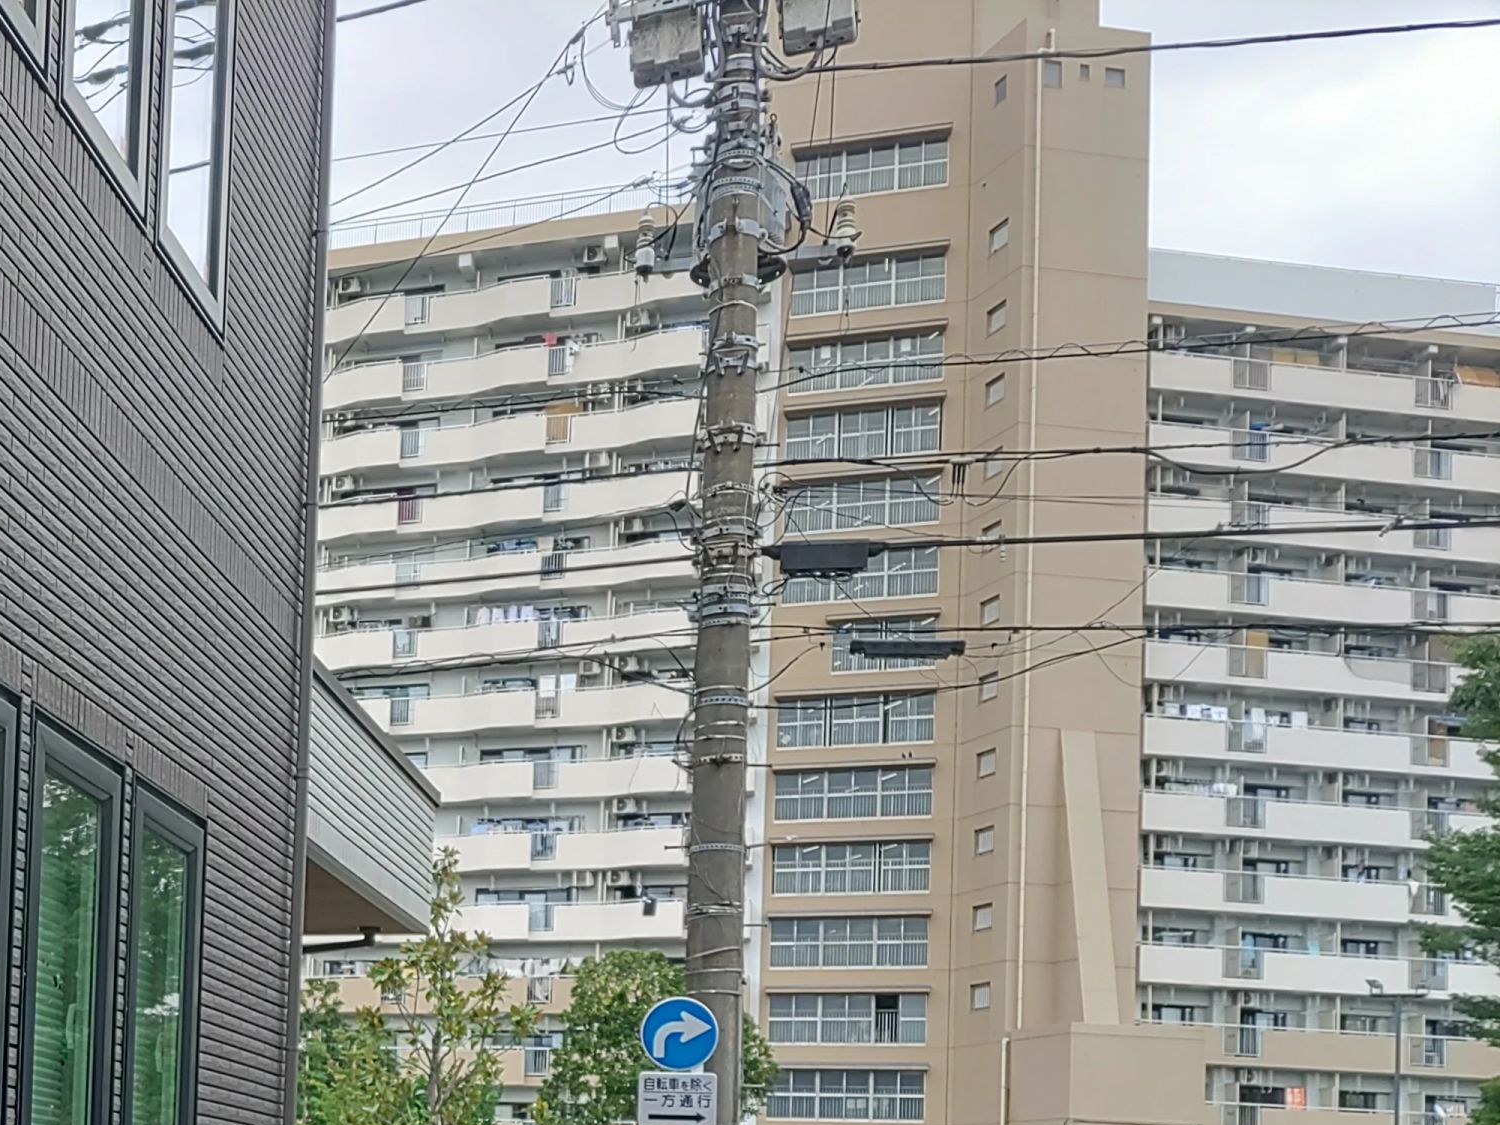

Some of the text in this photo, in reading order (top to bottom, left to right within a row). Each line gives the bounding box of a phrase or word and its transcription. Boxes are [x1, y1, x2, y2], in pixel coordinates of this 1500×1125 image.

[643, 1077, 712, 1091] 自転車を除く
[643, 1094, 712, 1108] 一方通行
